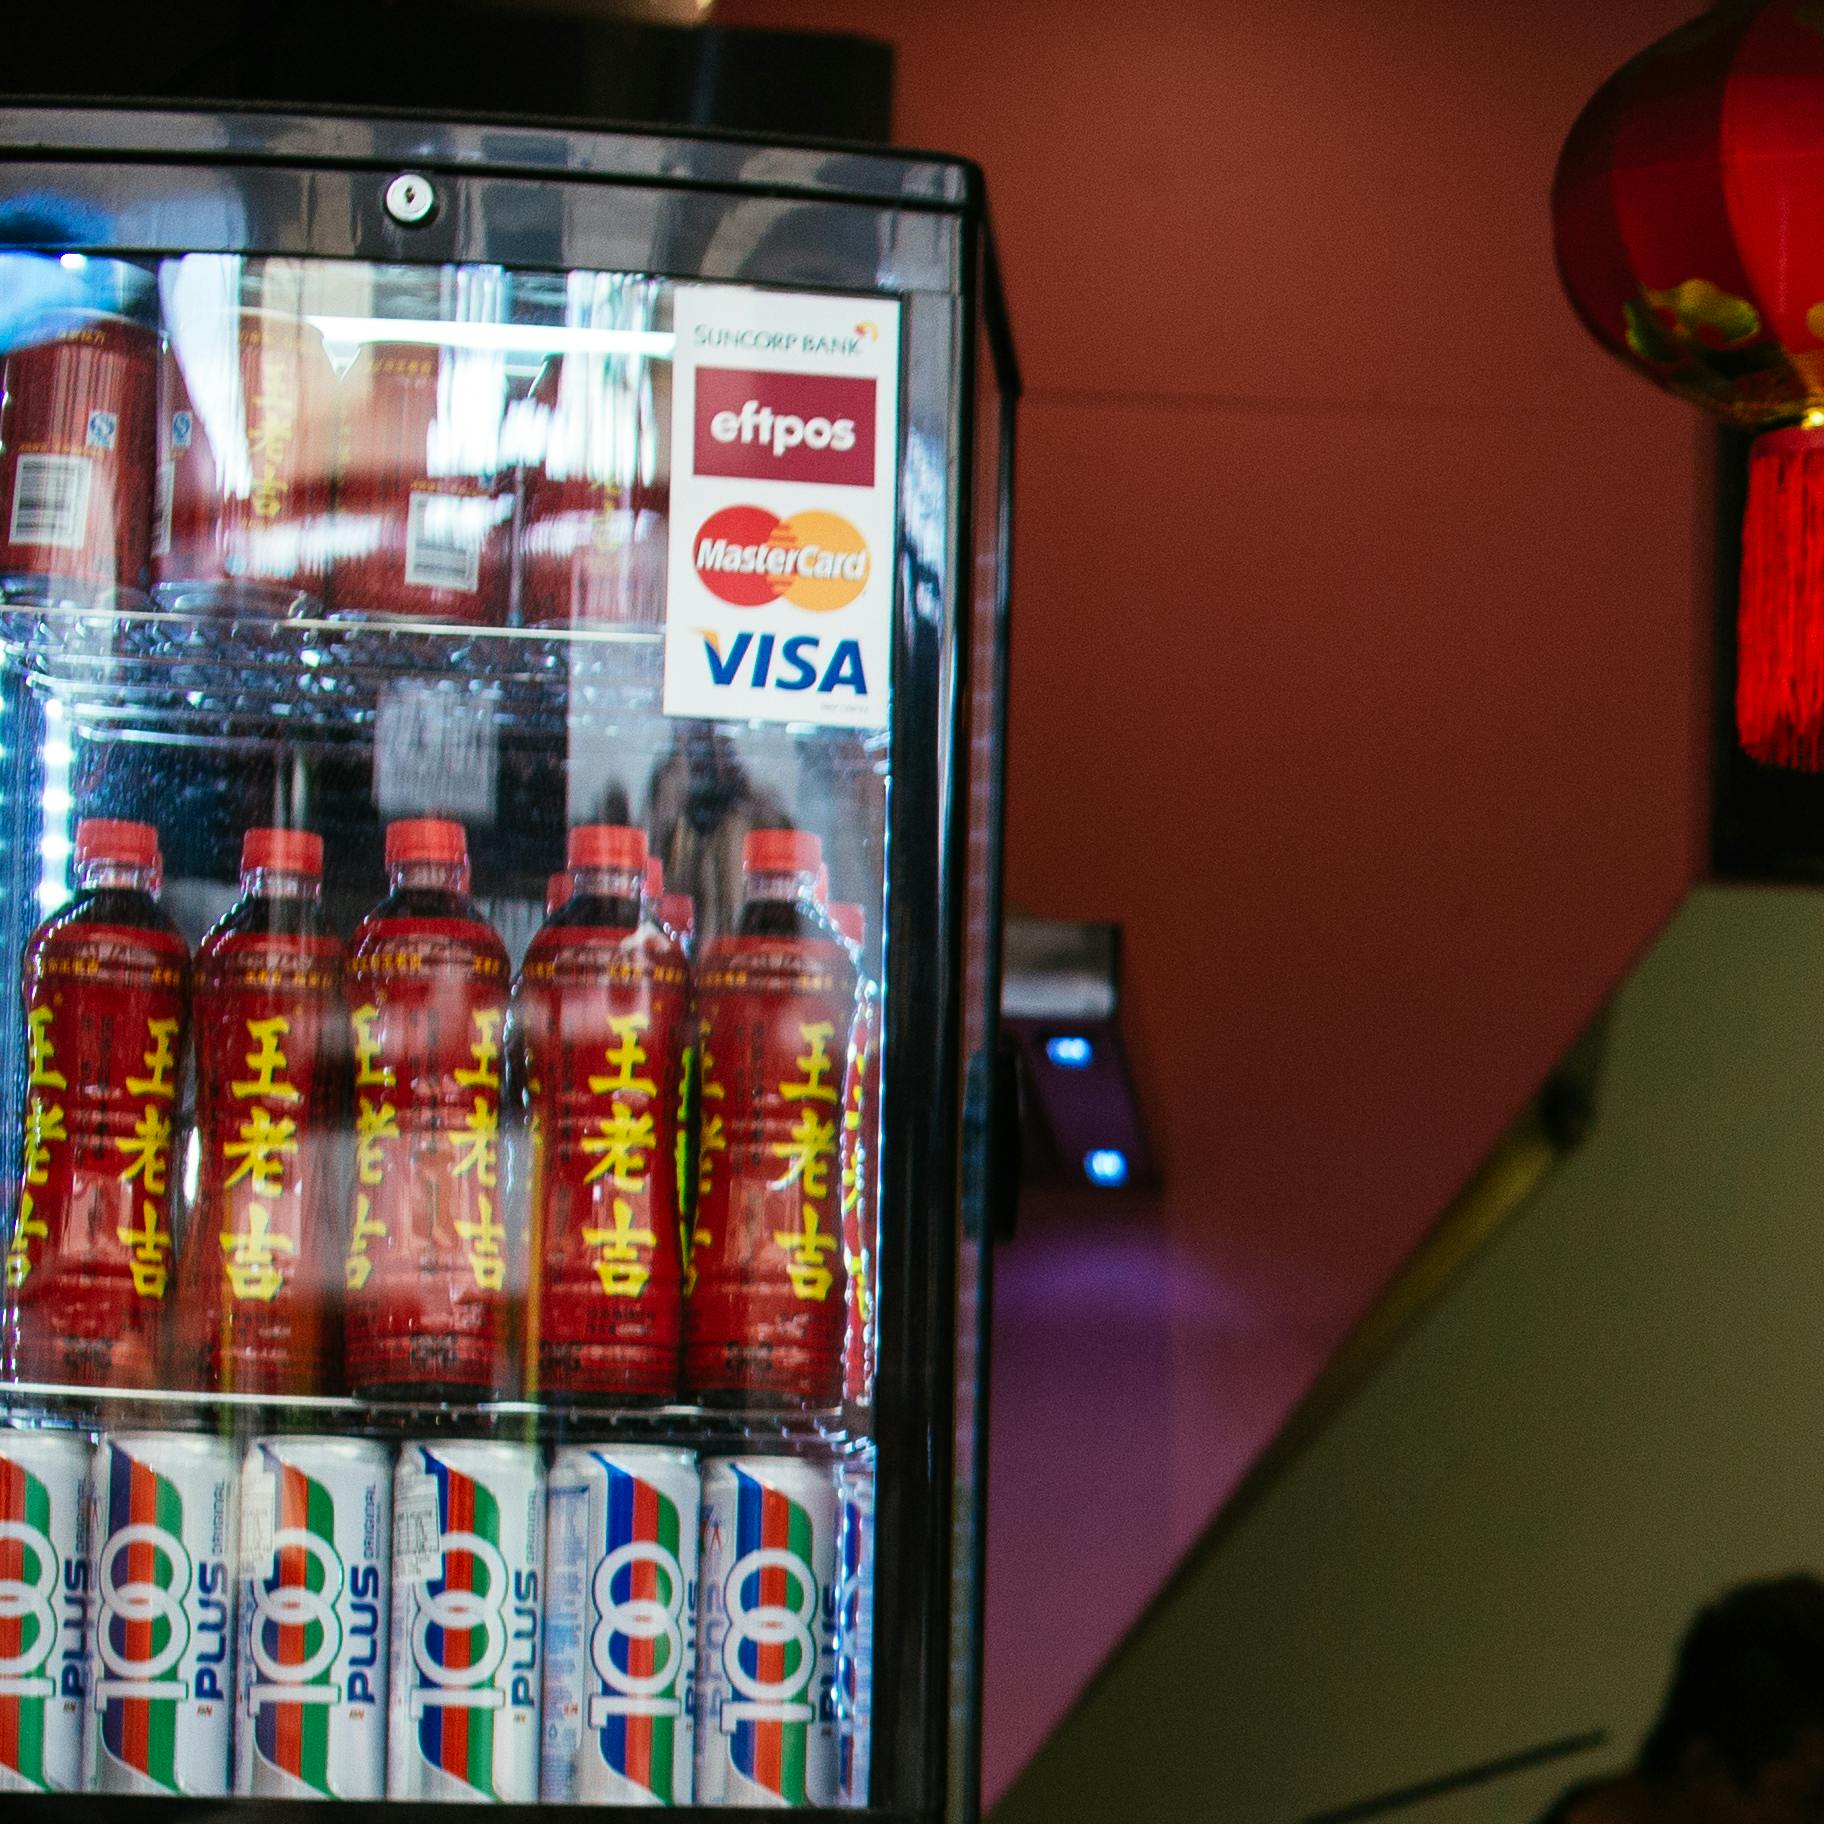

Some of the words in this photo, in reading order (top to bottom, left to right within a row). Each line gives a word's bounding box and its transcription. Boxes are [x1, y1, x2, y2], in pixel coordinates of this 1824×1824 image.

[694, 323, 798, 351] SUNCORP
[802, 335, 862, 355] BANK
[711, 400, 856, 457] eftpos
[697, 538, 866, 580] MasterCard
[694, 628, 868, 695] VISA
[219, 1016, 302, 1302] 王老吉
[580, 1012, 657, 1299] 王老吉
[770, 1020, 838, 1302] 王老吉
[95, 1521, 192, 1714] 100
[195, 1560, 228, 1700] PLUS
[347, 1564, 379, 1704] PLUS
[512, 1568, 538, 1710] PLUS
[588, 1540, 684, 1730] 100
[720, 1548, 818, 1735] 100
